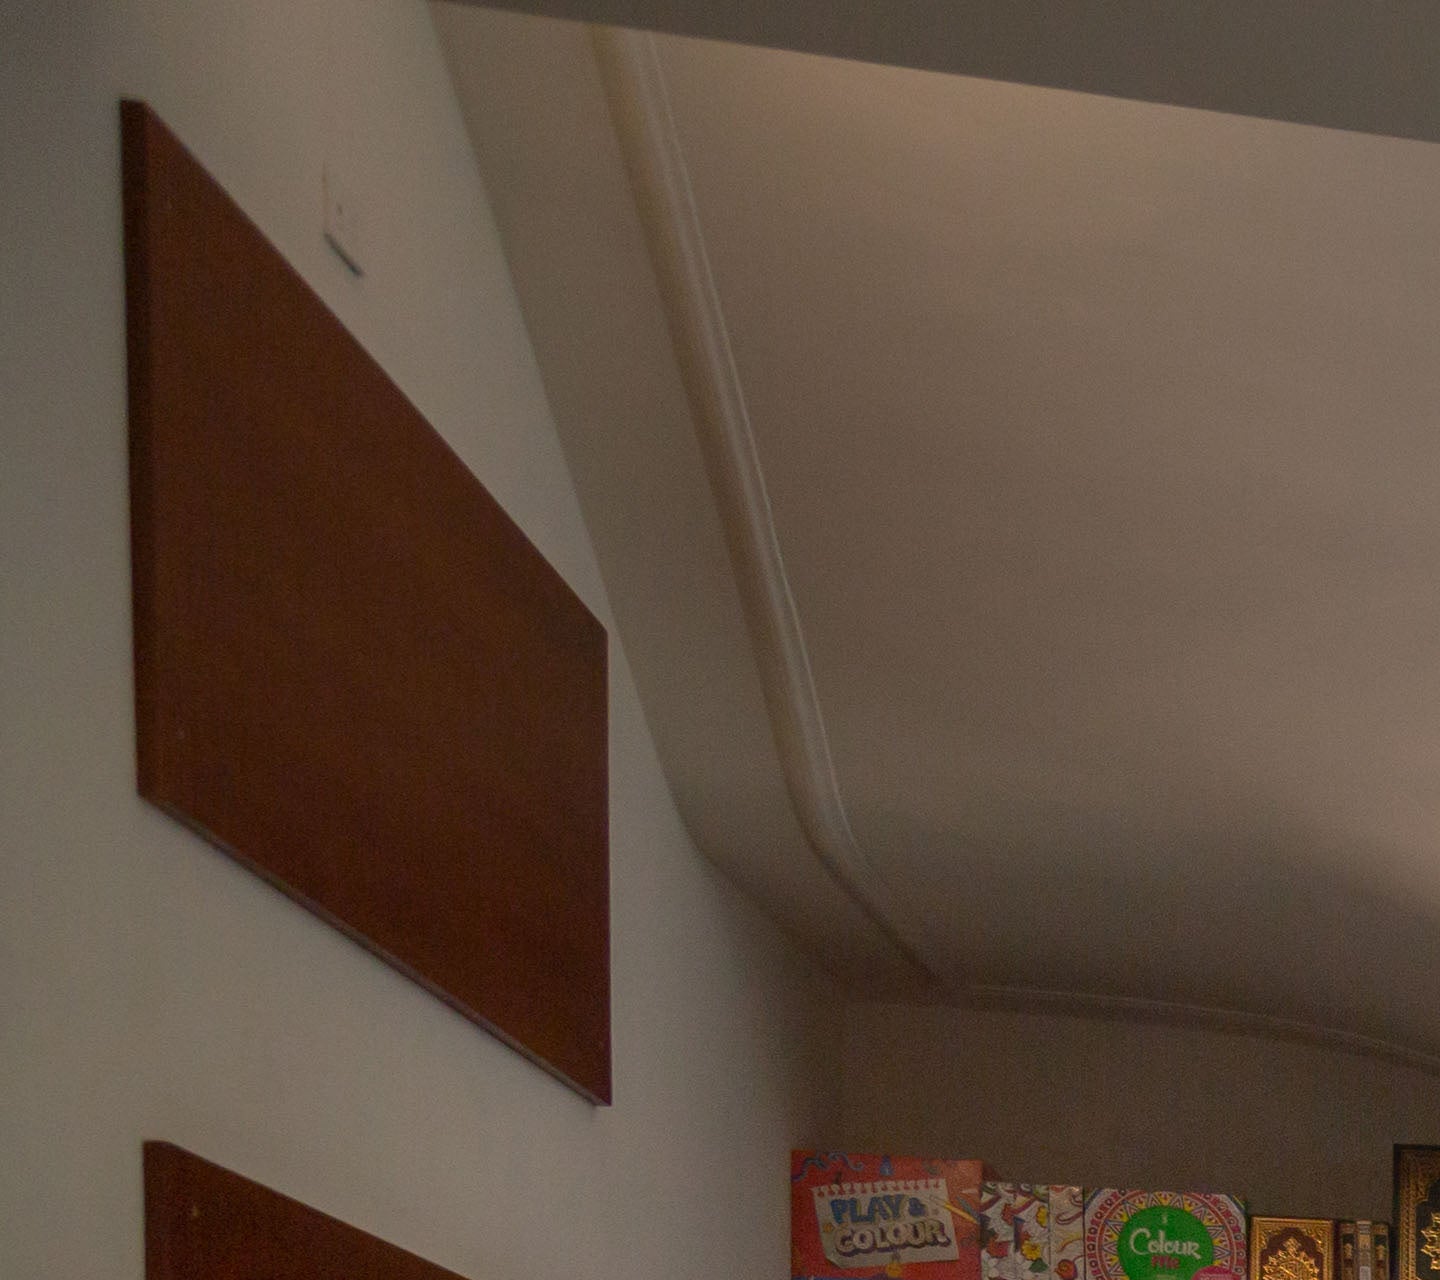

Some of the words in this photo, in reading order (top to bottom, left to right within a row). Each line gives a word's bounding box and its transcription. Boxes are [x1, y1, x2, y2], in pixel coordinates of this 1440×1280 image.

[831, 1196, 907, 1224] PLAY
[834, 1221, 950, 1257] COLOUR
[1129, 1229, 1201, 1260] Colour
